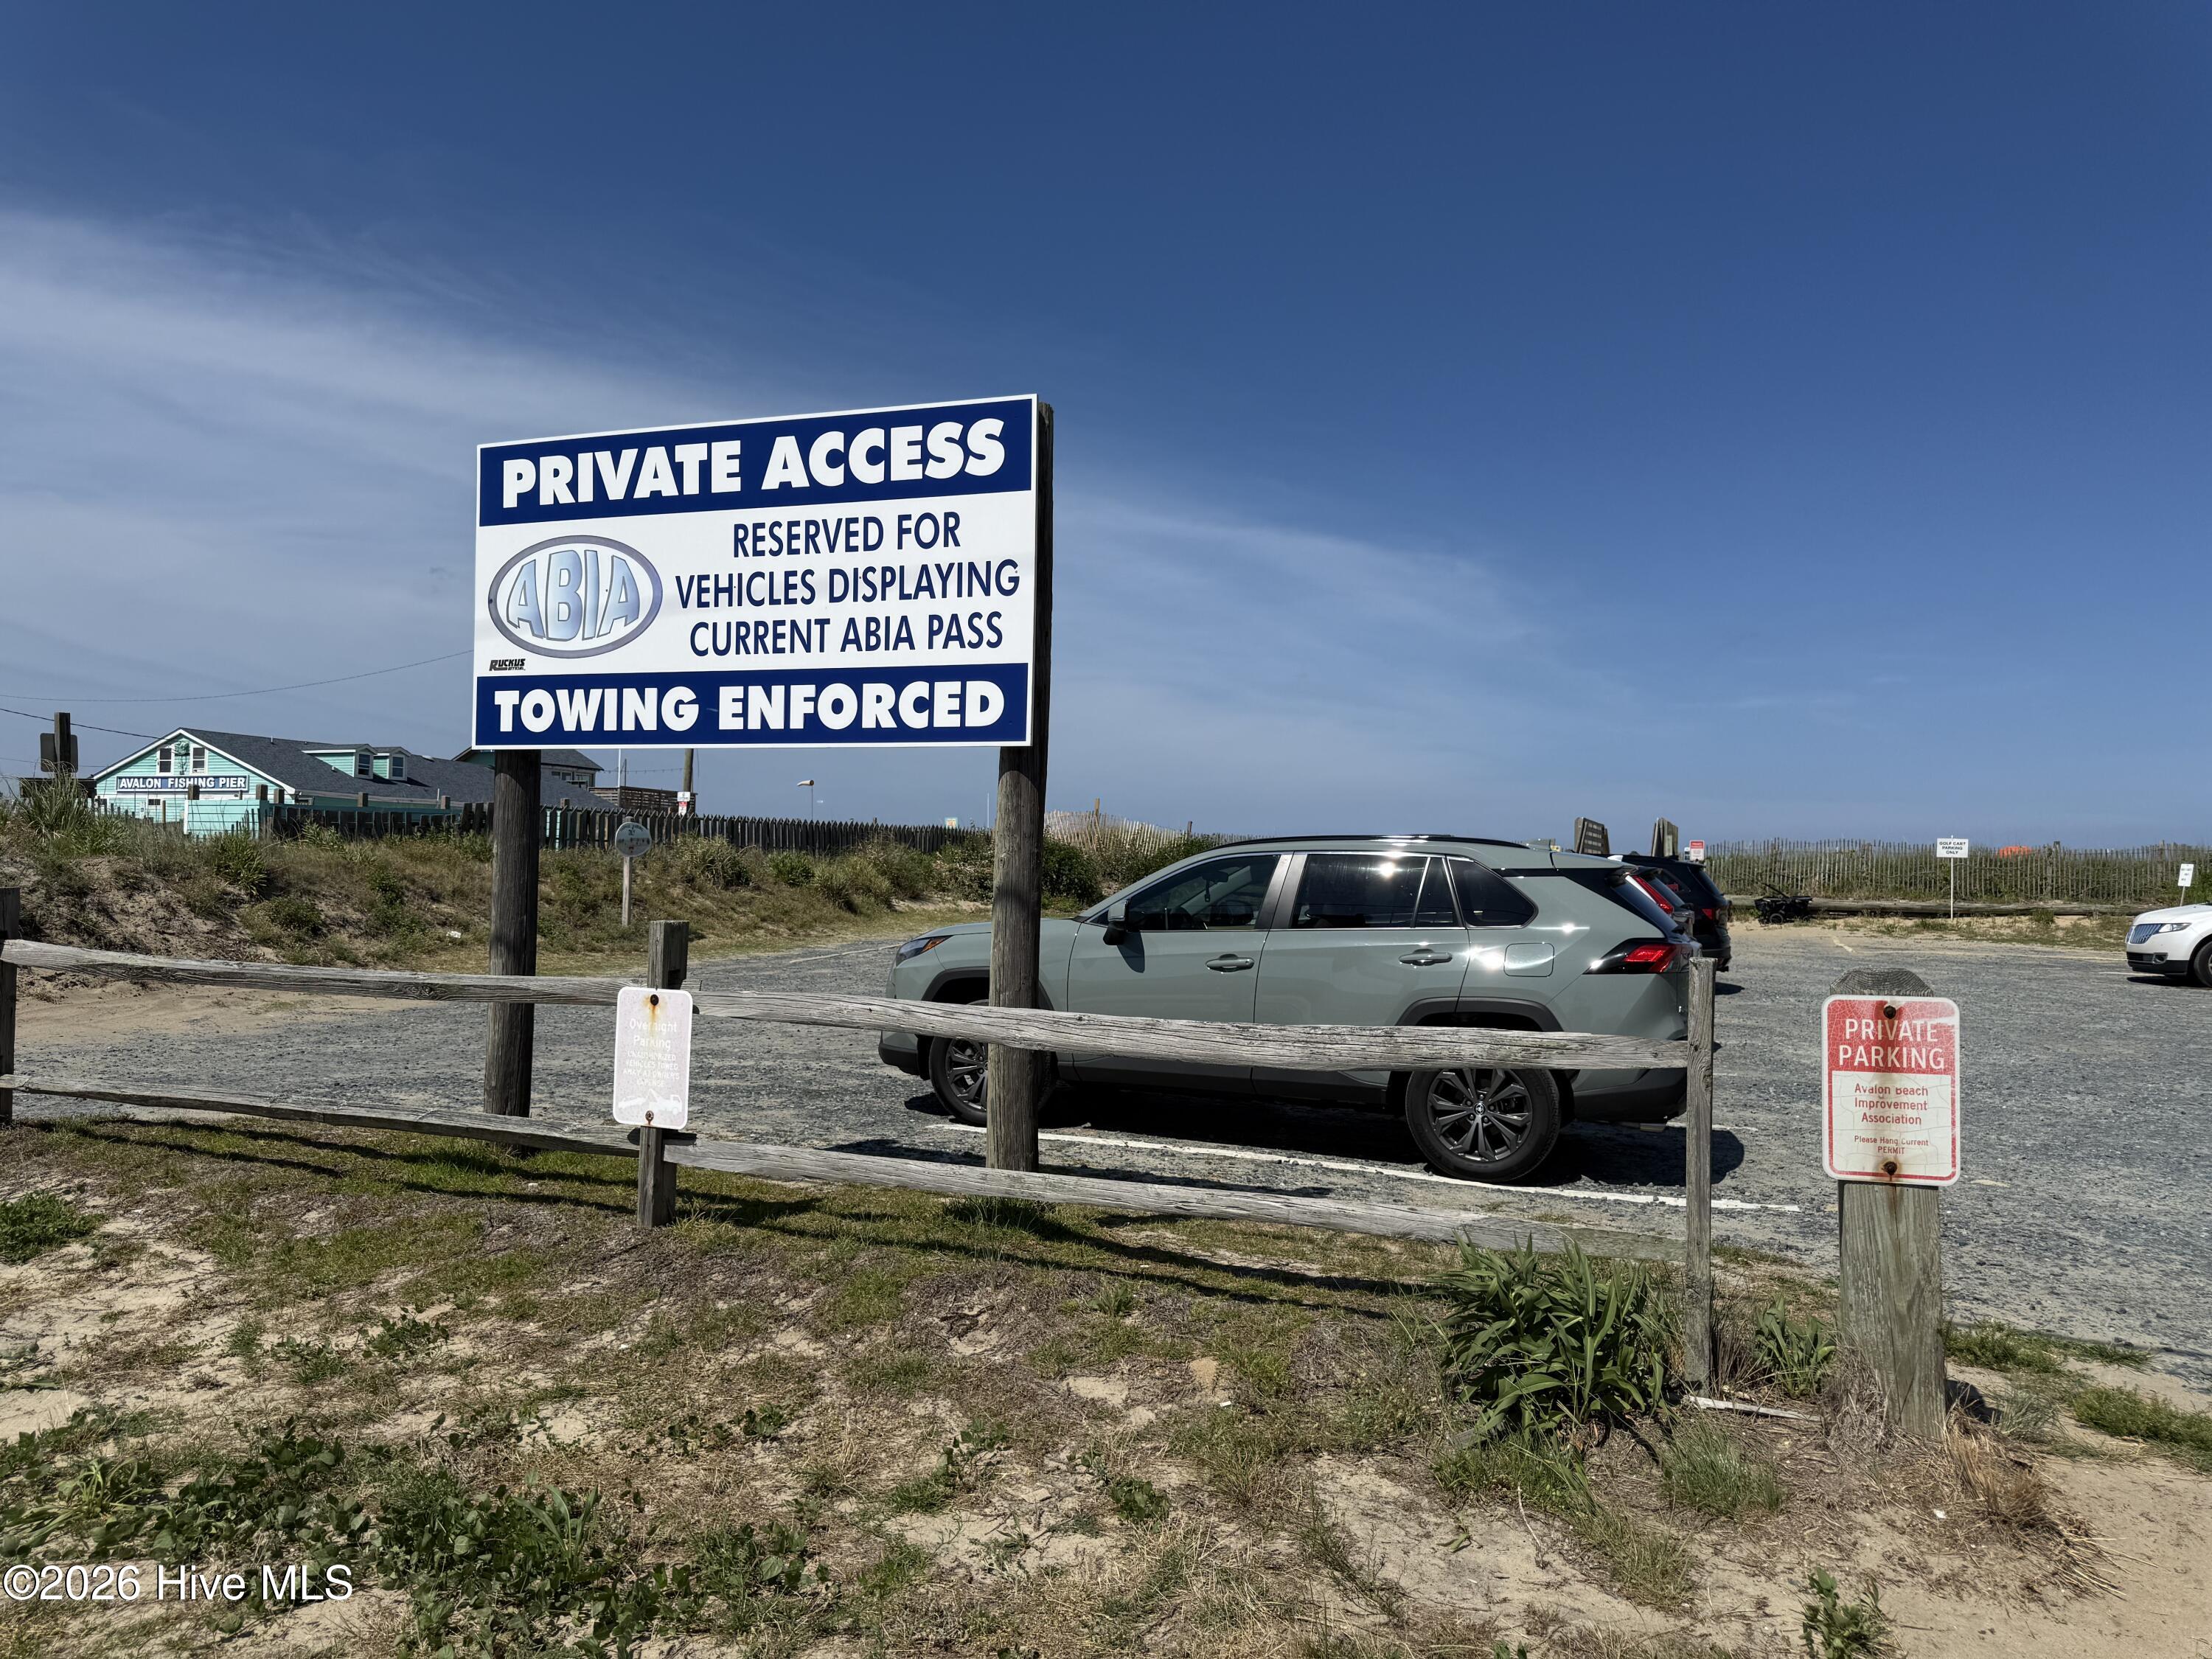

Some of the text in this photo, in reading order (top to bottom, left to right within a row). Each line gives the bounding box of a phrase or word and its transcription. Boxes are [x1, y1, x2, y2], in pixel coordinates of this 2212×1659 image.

[502, 418, 1006, 509] PRIVATE ACCESS
[734, 512, 961, 558] RESERVED FOR
[506, 549, 641, 641] ABIA
[675, 559, 1020, 609] VEHICLES DISPLAYING
[689, 611, 1003, 657] CURRENT ABIA PASS
[489, 658, 526, 671] RUCKUS
[494, 681, 1005, 732] TOWING ENFORCED
[119, 776, 246, 789] AVALON FISHING PIER
[1845, 1019, 1938, 1042] PRIVATE
[1838, 1045, 1945, 1069] PARKING
[1854, 1083, 1929, 1096] Avalon Beach
[1854, 1097, 1928, 1111] Improvement
[1861, 1112, 1922, 1125] Association
[1854, 1135, 1929, 1147] Please Hang Current
[1877, 1146, 1905, 1155] PERMIT
